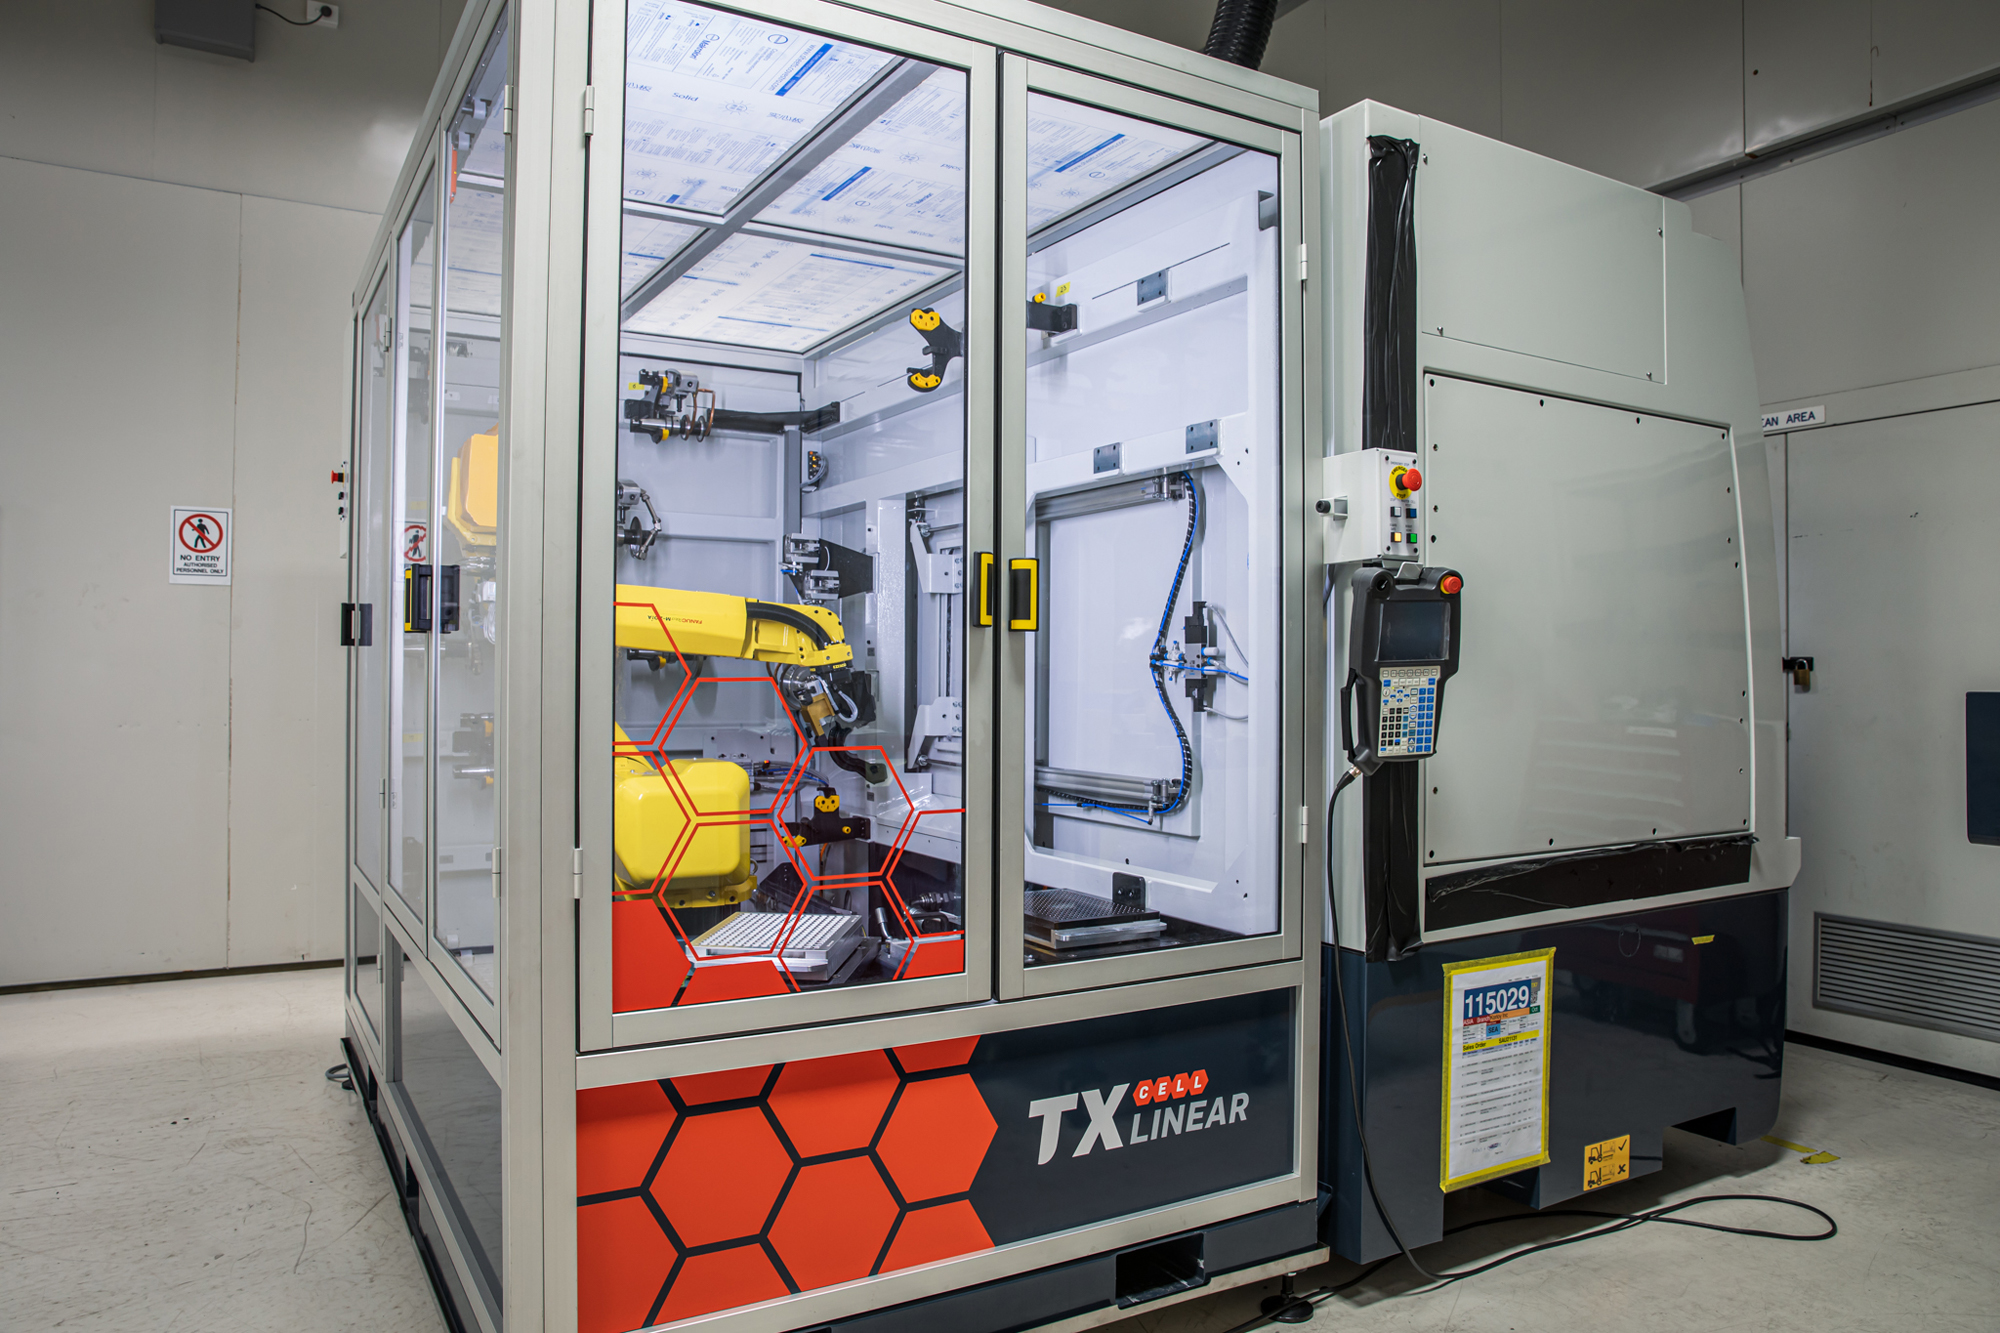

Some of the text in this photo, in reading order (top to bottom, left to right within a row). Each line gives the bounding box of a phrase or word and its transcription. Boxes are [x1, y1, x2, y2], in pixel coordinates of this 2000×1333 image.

[1786, 411, 1816, 424] AREA
[1465, 985, 1529, 1018] 115029
[1463, 1018, 1474, 1026] ASIA
[1477, 1015, 1490, 1023] Branch
[1463, 1043, 1474, 1052] Sales
[1139, 1076, 1202, 1100] CELL
[1029, 1083, 1130, 1165] TX
[1129, 1092, 1250, 1145] LINEAR
